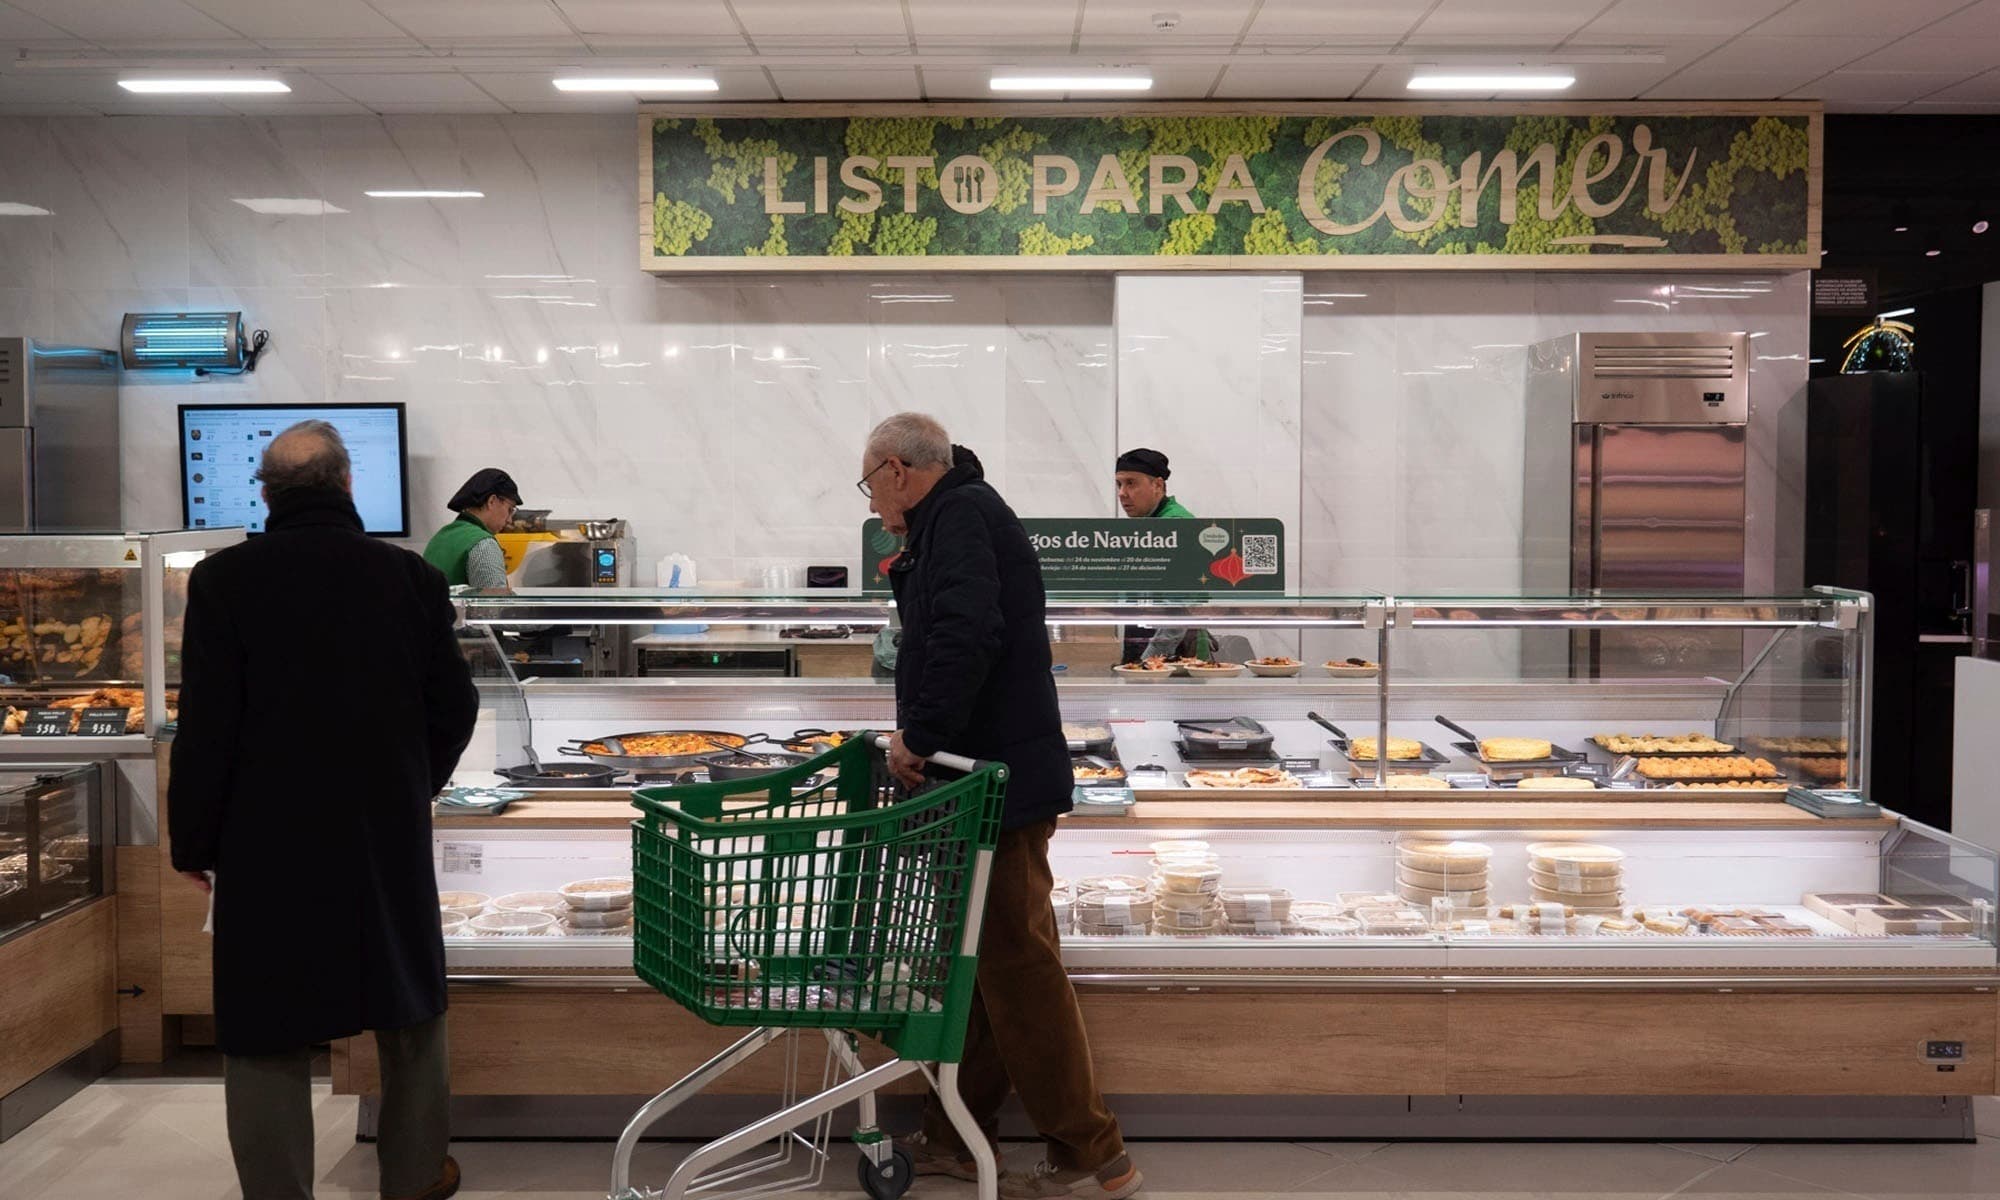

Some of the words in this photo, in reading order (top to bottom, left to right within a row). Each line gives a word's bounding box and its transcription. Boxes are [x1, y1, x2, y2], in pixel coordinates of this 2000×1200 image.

[764, 154, 999, 215] LISTO
[1032, 153, 1265, 215] PARA
[1298, 123, 1698, 236] Comer
[1065, 531, 1090, 549] de
[1093, 531, 1178, 549] Navidad
